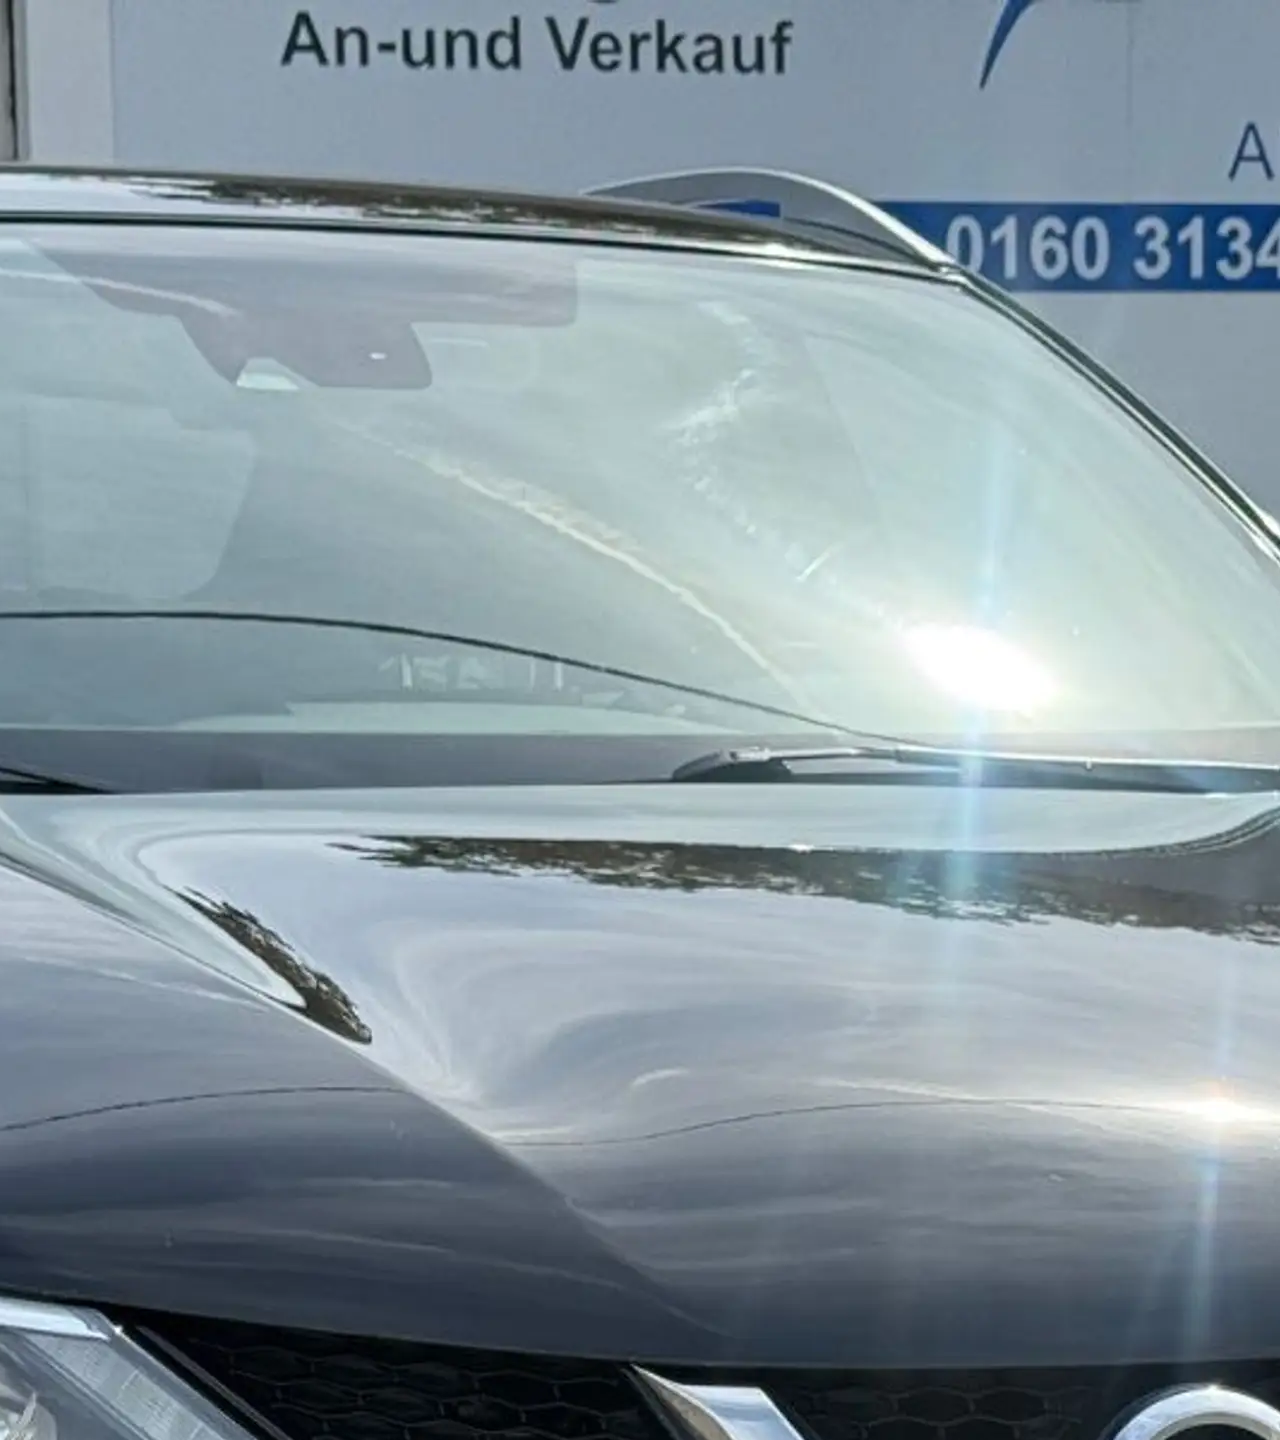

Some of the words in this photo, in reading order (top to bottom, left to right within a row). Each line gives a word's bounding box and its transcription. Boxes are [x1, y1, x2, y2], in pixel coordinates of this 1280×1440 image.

[280, 10, 522, 70] An-und
[544, 16, 793, 75] Verkauf
[946, 215, 1110, 279] 0160
